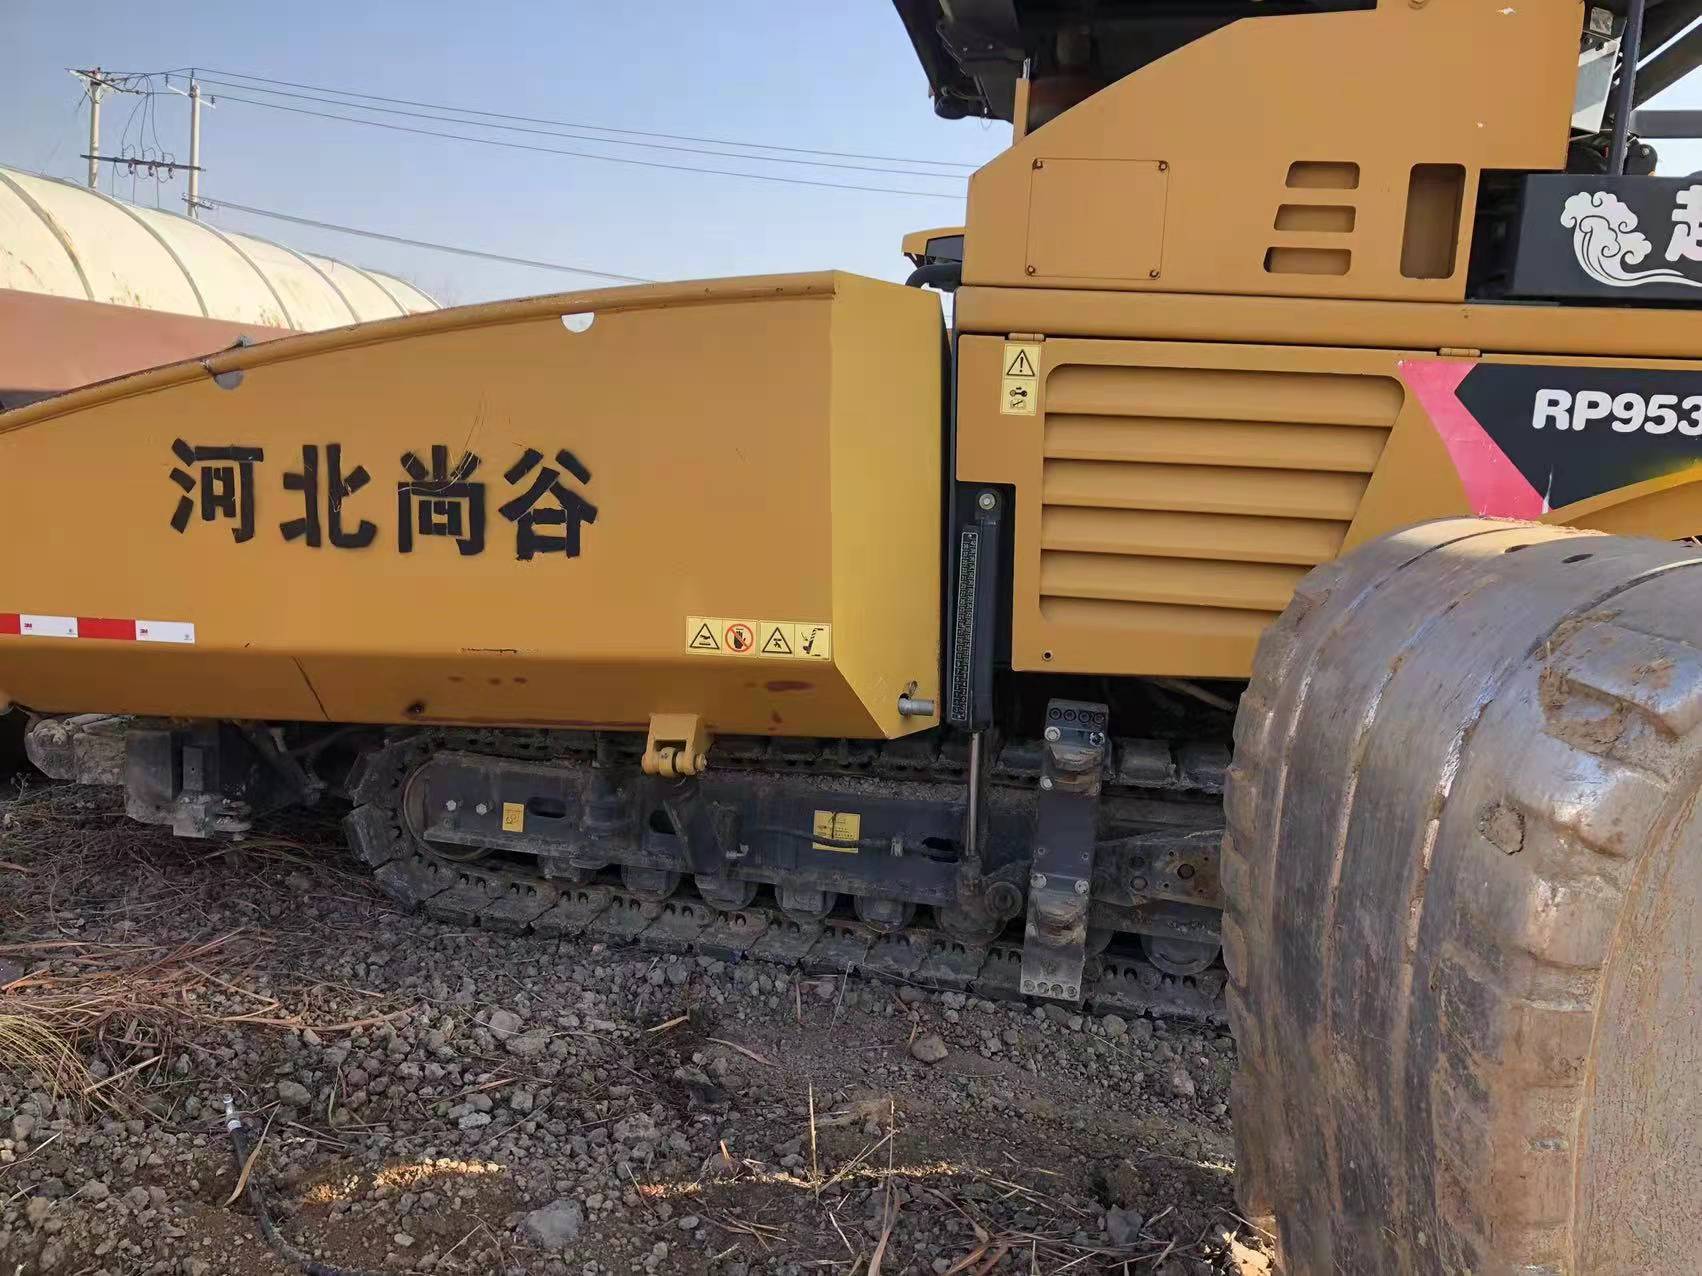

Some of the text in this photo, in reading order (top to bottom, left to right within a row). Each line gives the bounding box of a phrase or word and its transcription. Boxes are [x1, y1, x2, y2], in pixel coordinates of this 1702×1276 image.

[1532, 388, 1702, 436] RP953
[170, 437, 598, 560] 河北尚谷
